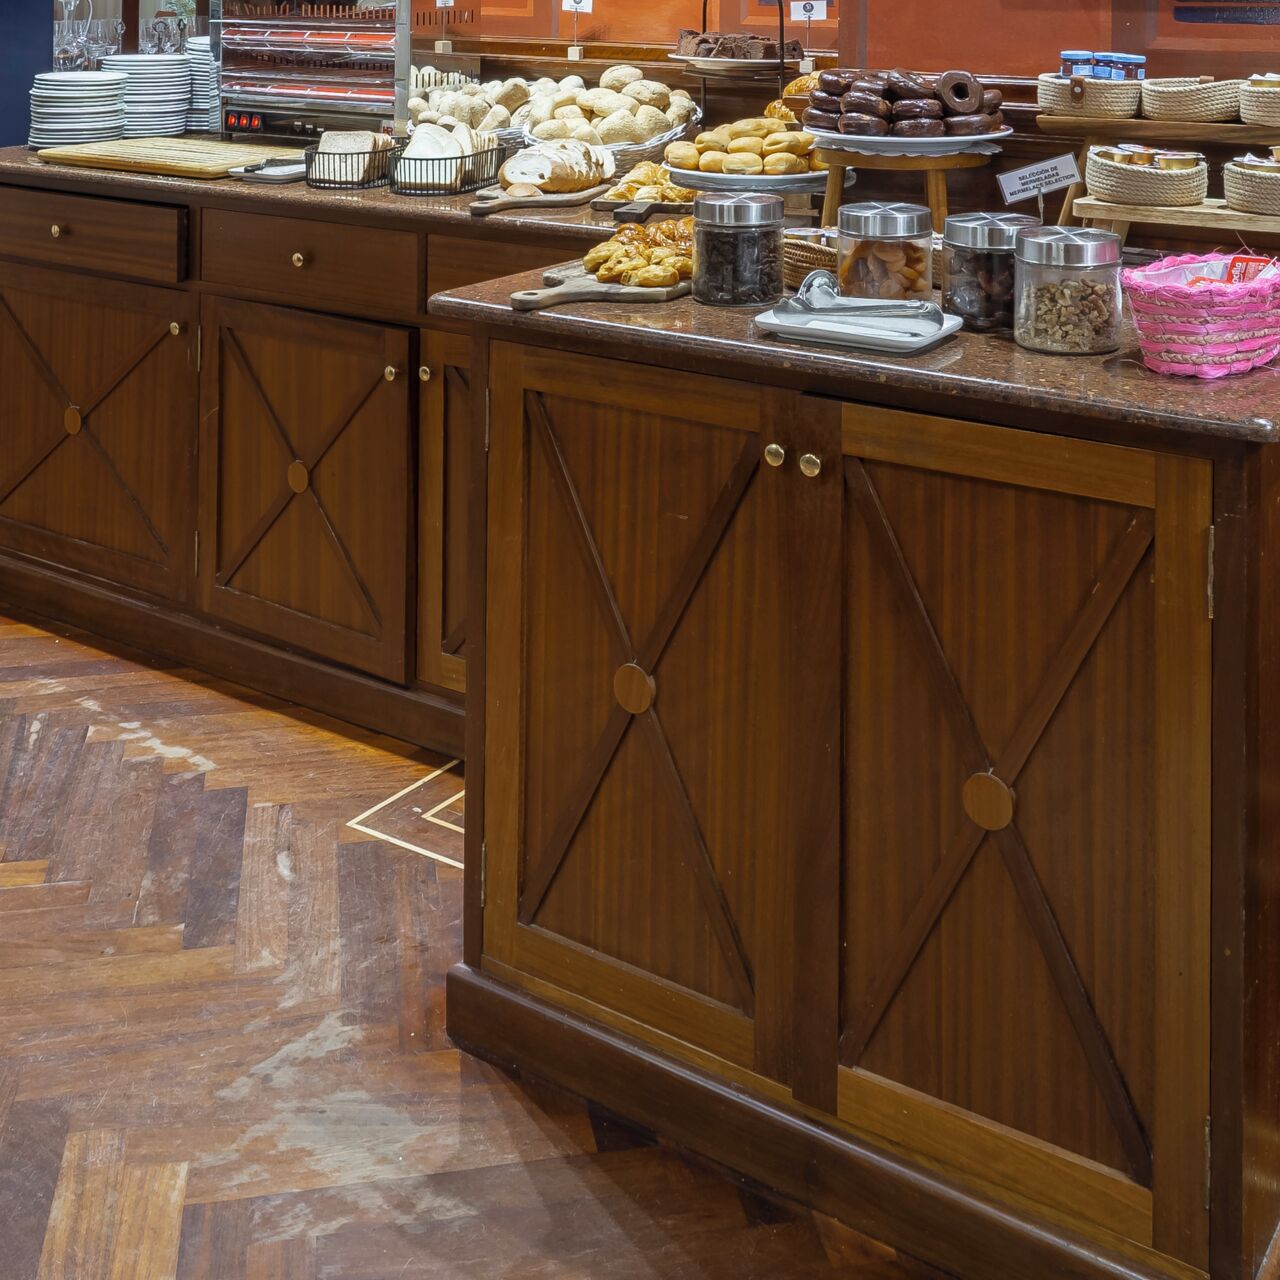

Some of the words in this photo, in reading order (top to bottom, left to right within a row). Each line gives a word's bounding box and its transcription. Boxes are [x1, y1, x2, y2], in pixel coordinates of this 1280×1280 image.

[1018, 168, 1050, 182] SELECCIÓN
[1050, 165, 1058, 173] DE
[1021, 172, 1060, 187] MERMELADAS
[1044, 173, 1076, 187] SELECTION
